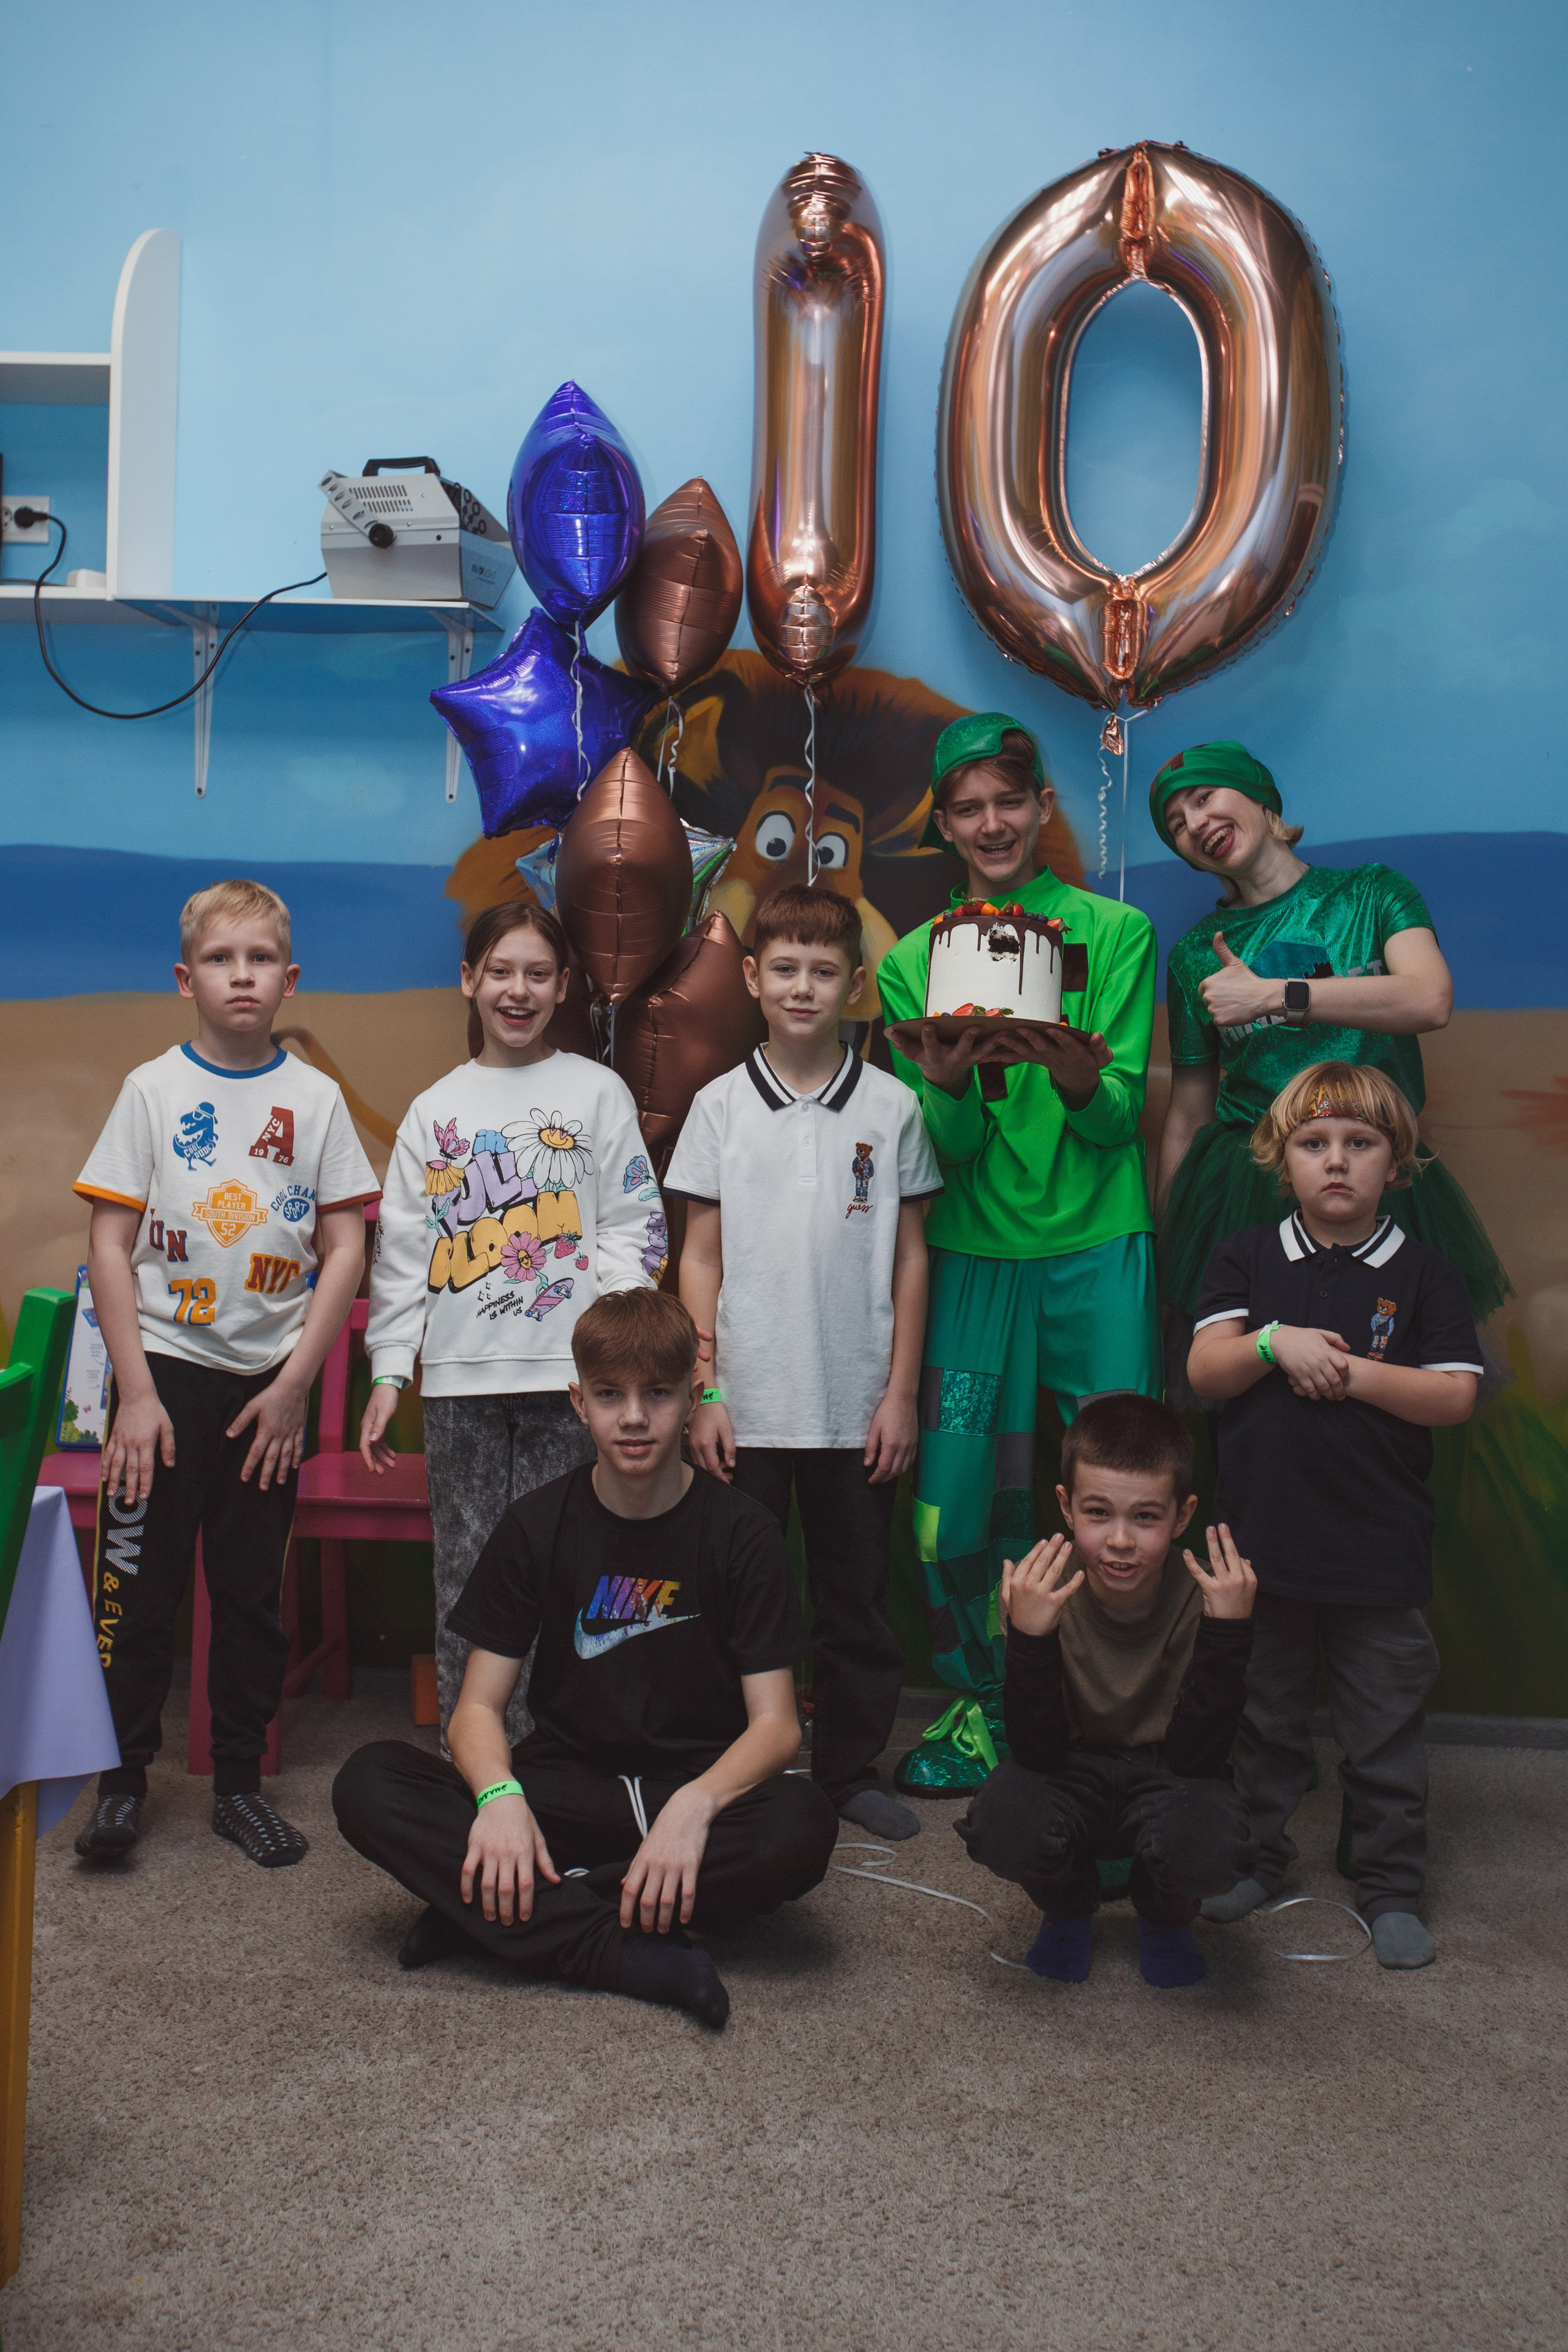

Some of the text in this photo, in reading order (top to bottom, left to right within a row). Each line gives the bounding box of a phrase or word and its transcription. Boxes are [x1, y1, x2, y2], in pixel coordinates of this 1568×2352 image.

[262, 1118, 280, 1142] NYC
[183, 1143, 202, 1158] COOL
[194, 1144, 212, 1159] DUDE
[279, 1155, 289, 1163] 76
[217, 1201, 246, 1210] PLAYER
[224, 1192, 243, 1201] BEST
[271, 1190, 287, 1212] COOL
[228, 1212, 255, 1221] DIVISION
[284, 1201, 306, 1219] SPORT
[845, 1204, 873, 1219] guess
[221, 1223, 236, 1237] 52
[245, 1253, 301, 1294] NYC
[168, 1278, 216, 1326] 72
[477, 1291, 514, 1318] HAPPINESS
[489, 1295, 523, 1320] IS WITHIN
[513, 1306, 522, 1316] US
[105, 1463, 148, 1575] OW
[103, 1572, 119, 1593] &
[586, 1575, 682, 1620] NIKE
